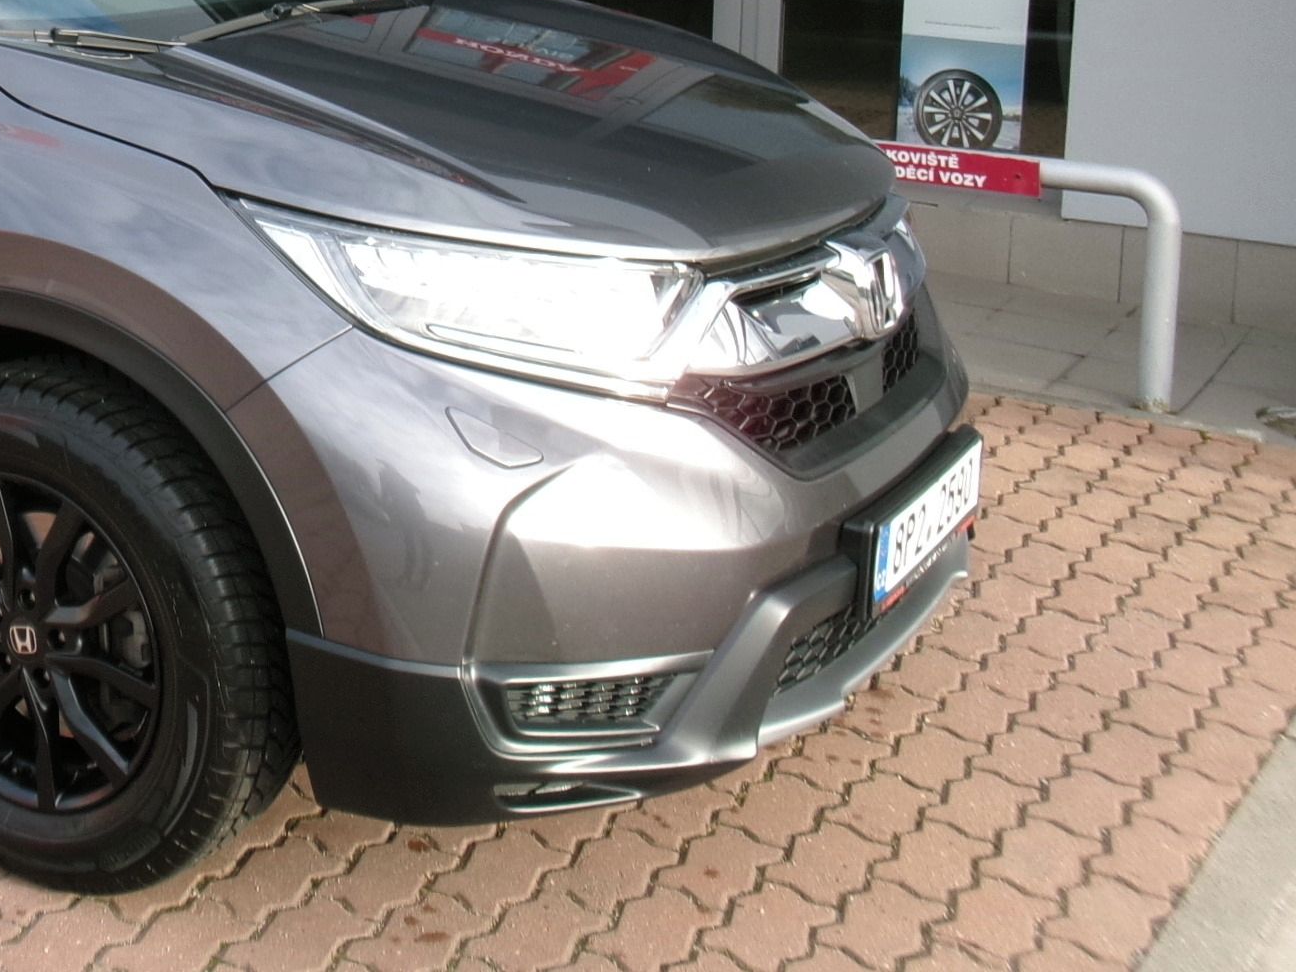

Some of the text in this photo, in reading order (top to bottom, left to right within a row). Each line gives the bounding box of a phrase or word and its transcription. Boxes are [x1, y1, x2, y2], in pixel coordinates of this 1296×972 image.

[885, 149, 959, 169] KOVIŠTĚ
[895, 165, 987, 188] DĚCÍ VOZY
